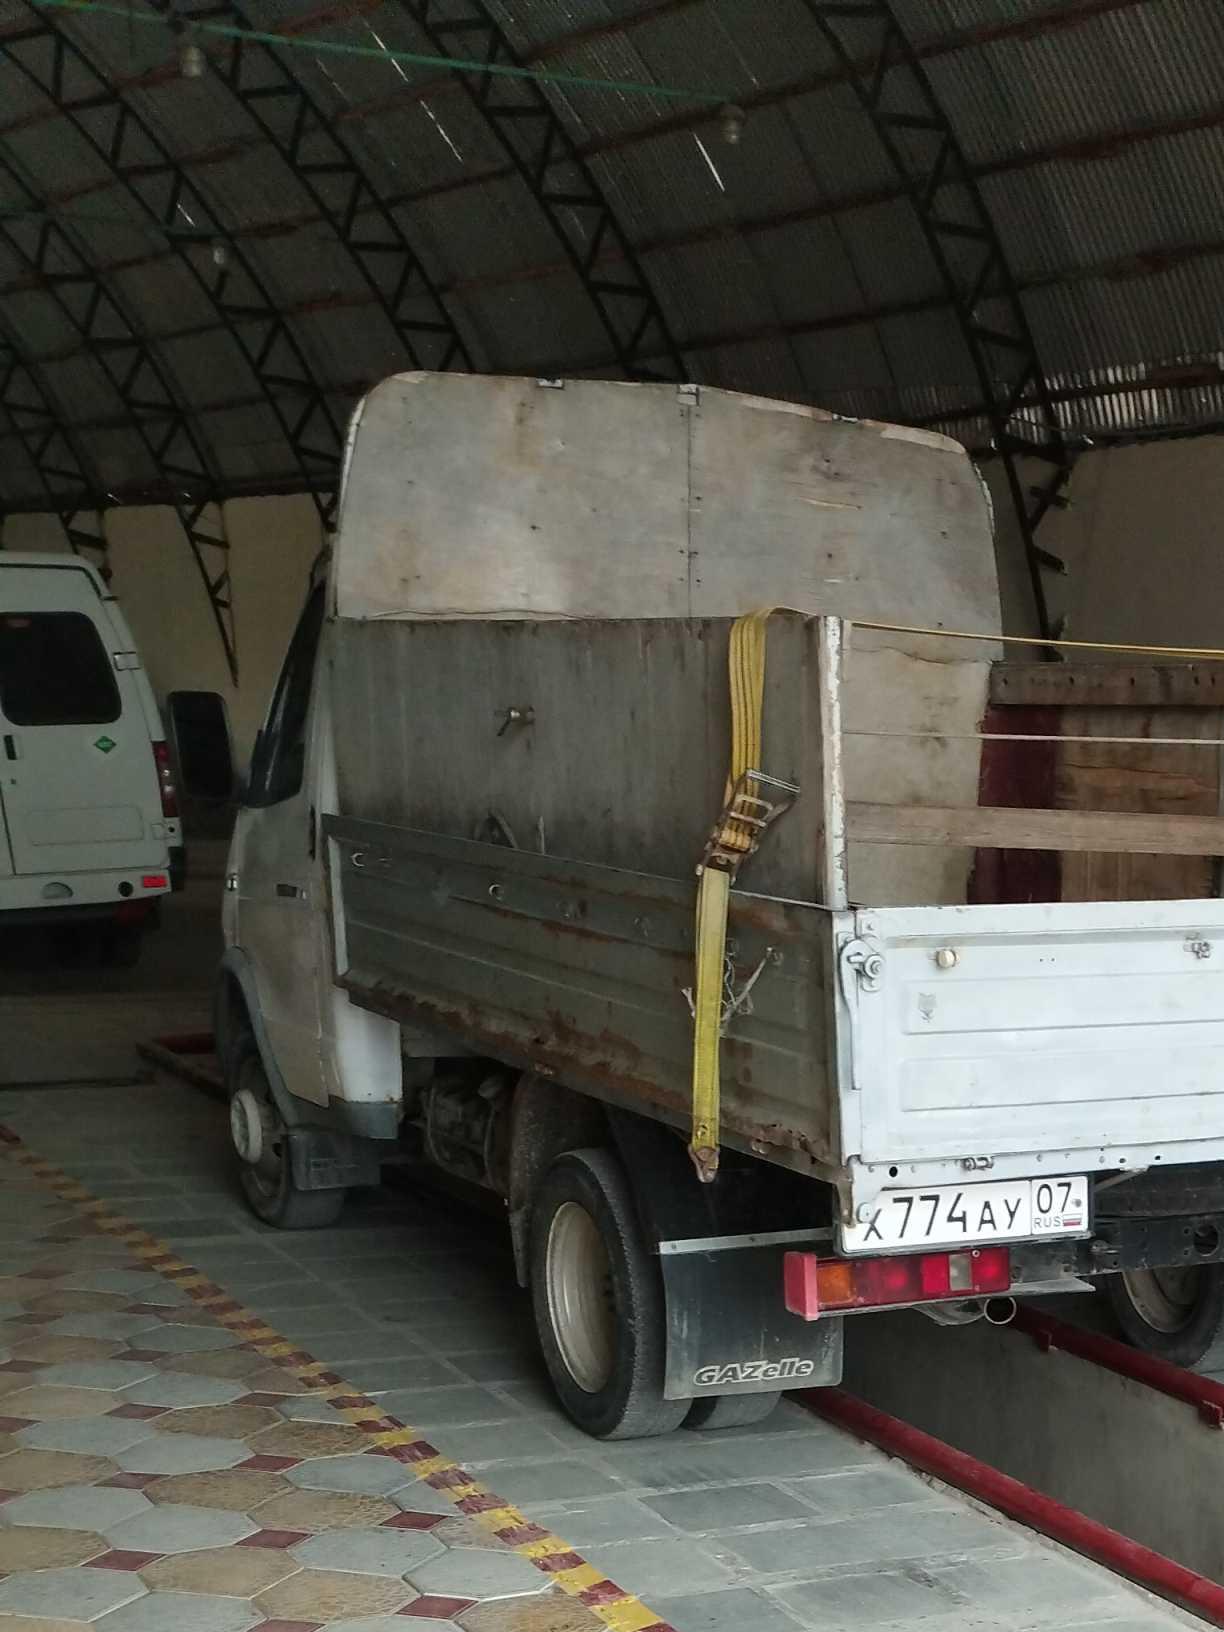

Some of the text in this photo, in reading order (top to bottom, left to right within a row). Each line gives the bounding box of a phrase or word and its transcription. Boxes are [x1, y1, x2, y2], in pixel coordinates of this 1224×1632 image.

[863, 1181, 1073, 1242] Х774АУ 07
[1034, 1215, 1063, 1229] RUS
[693, 1357, 815, 1386] GAZelle
